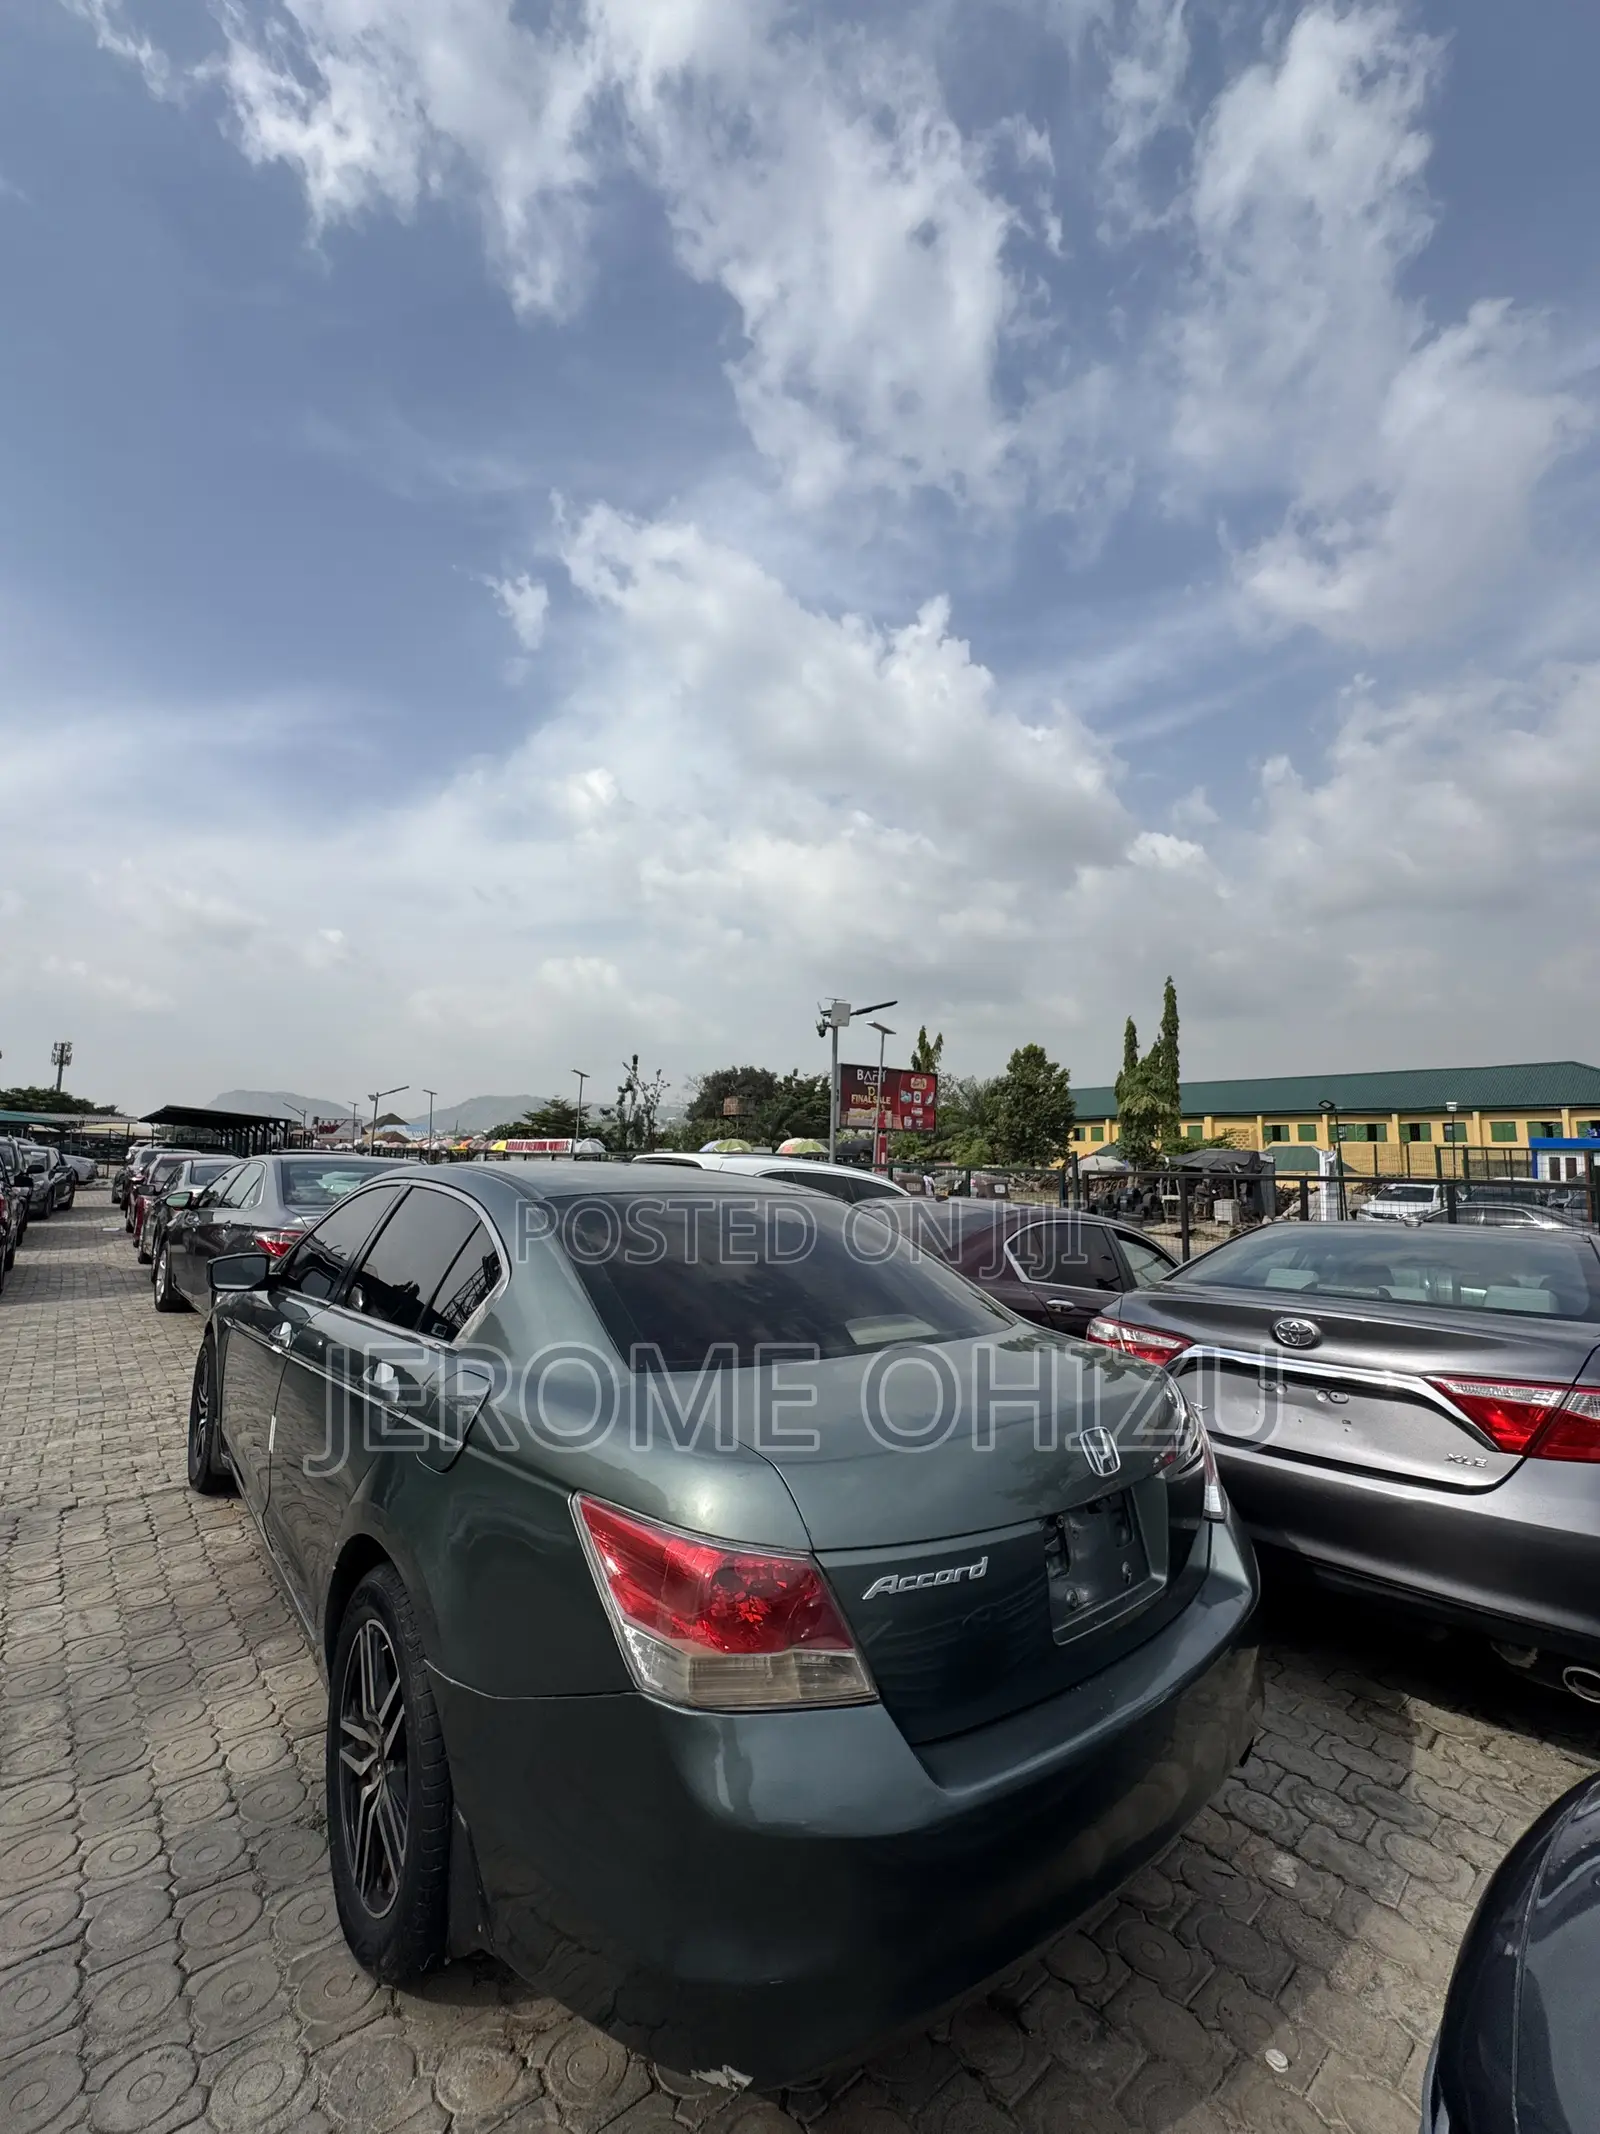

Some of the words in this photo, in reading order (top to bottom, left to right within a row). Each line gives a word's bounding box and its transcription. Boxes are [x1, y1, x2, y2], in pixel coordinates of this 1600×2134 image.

[857, 1069, 887, 1082] BAFY
[851, 1094, 873, 1105] FINAL
[1446, 1452, 1488, 1468] XLE
[862, 1556, 989, 1600] Accord
